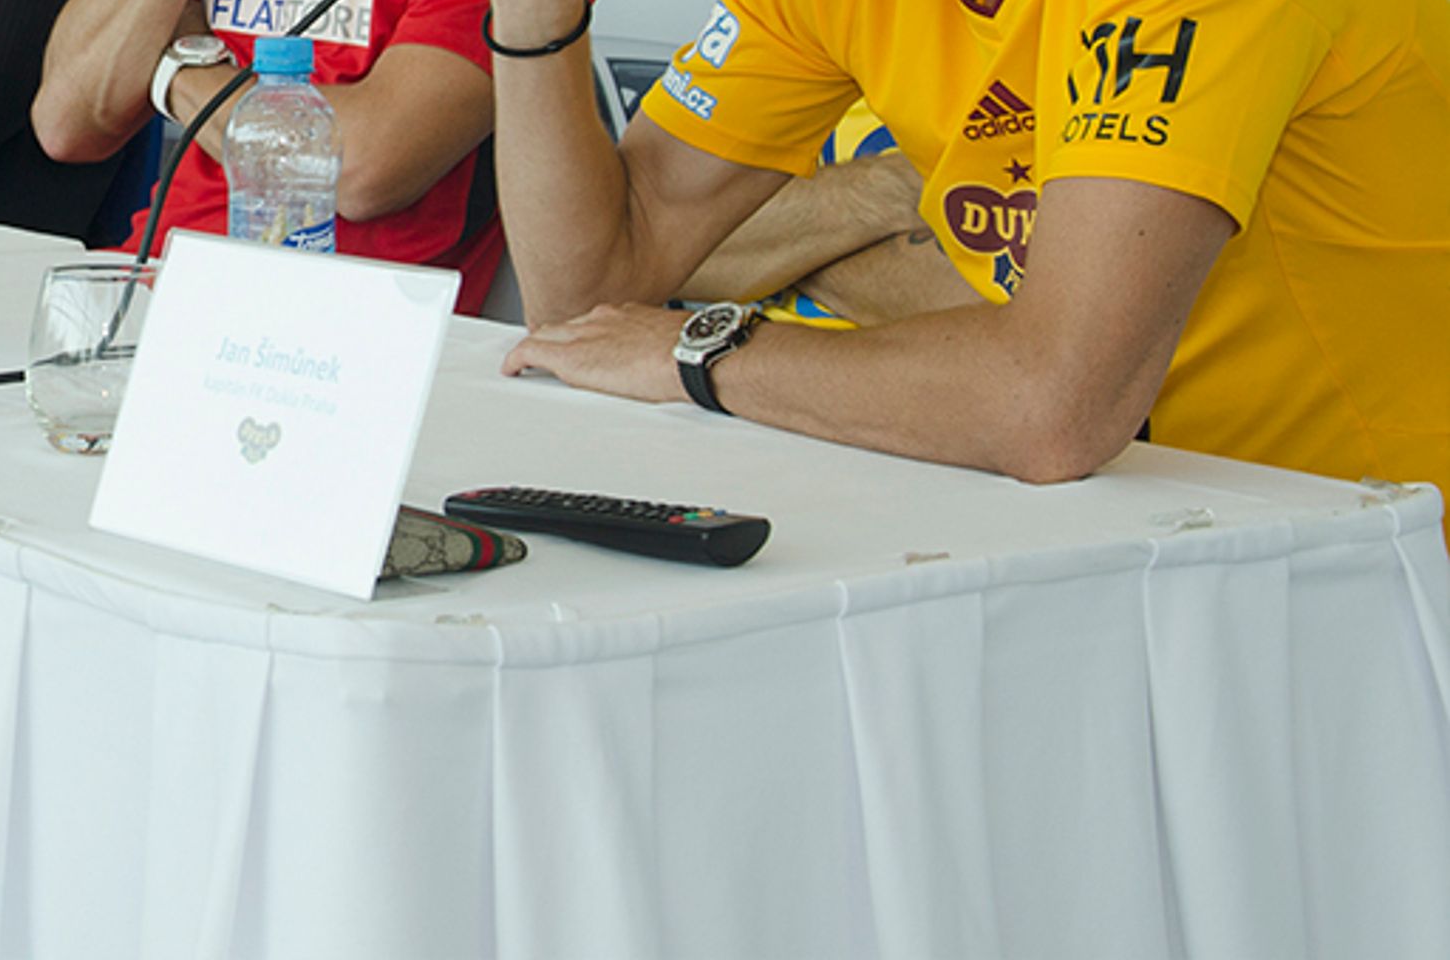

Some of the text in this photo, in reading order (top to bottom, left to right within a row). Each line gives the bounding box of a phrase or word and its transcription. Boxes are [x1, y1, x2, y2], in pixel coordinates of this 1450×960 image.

[963, 112, 1035, 141] adida
[1061, 113, 1169, 147] OTELS
[961, 200, 1037, 246] DUK
[215, 336, 250, 363] Jan
